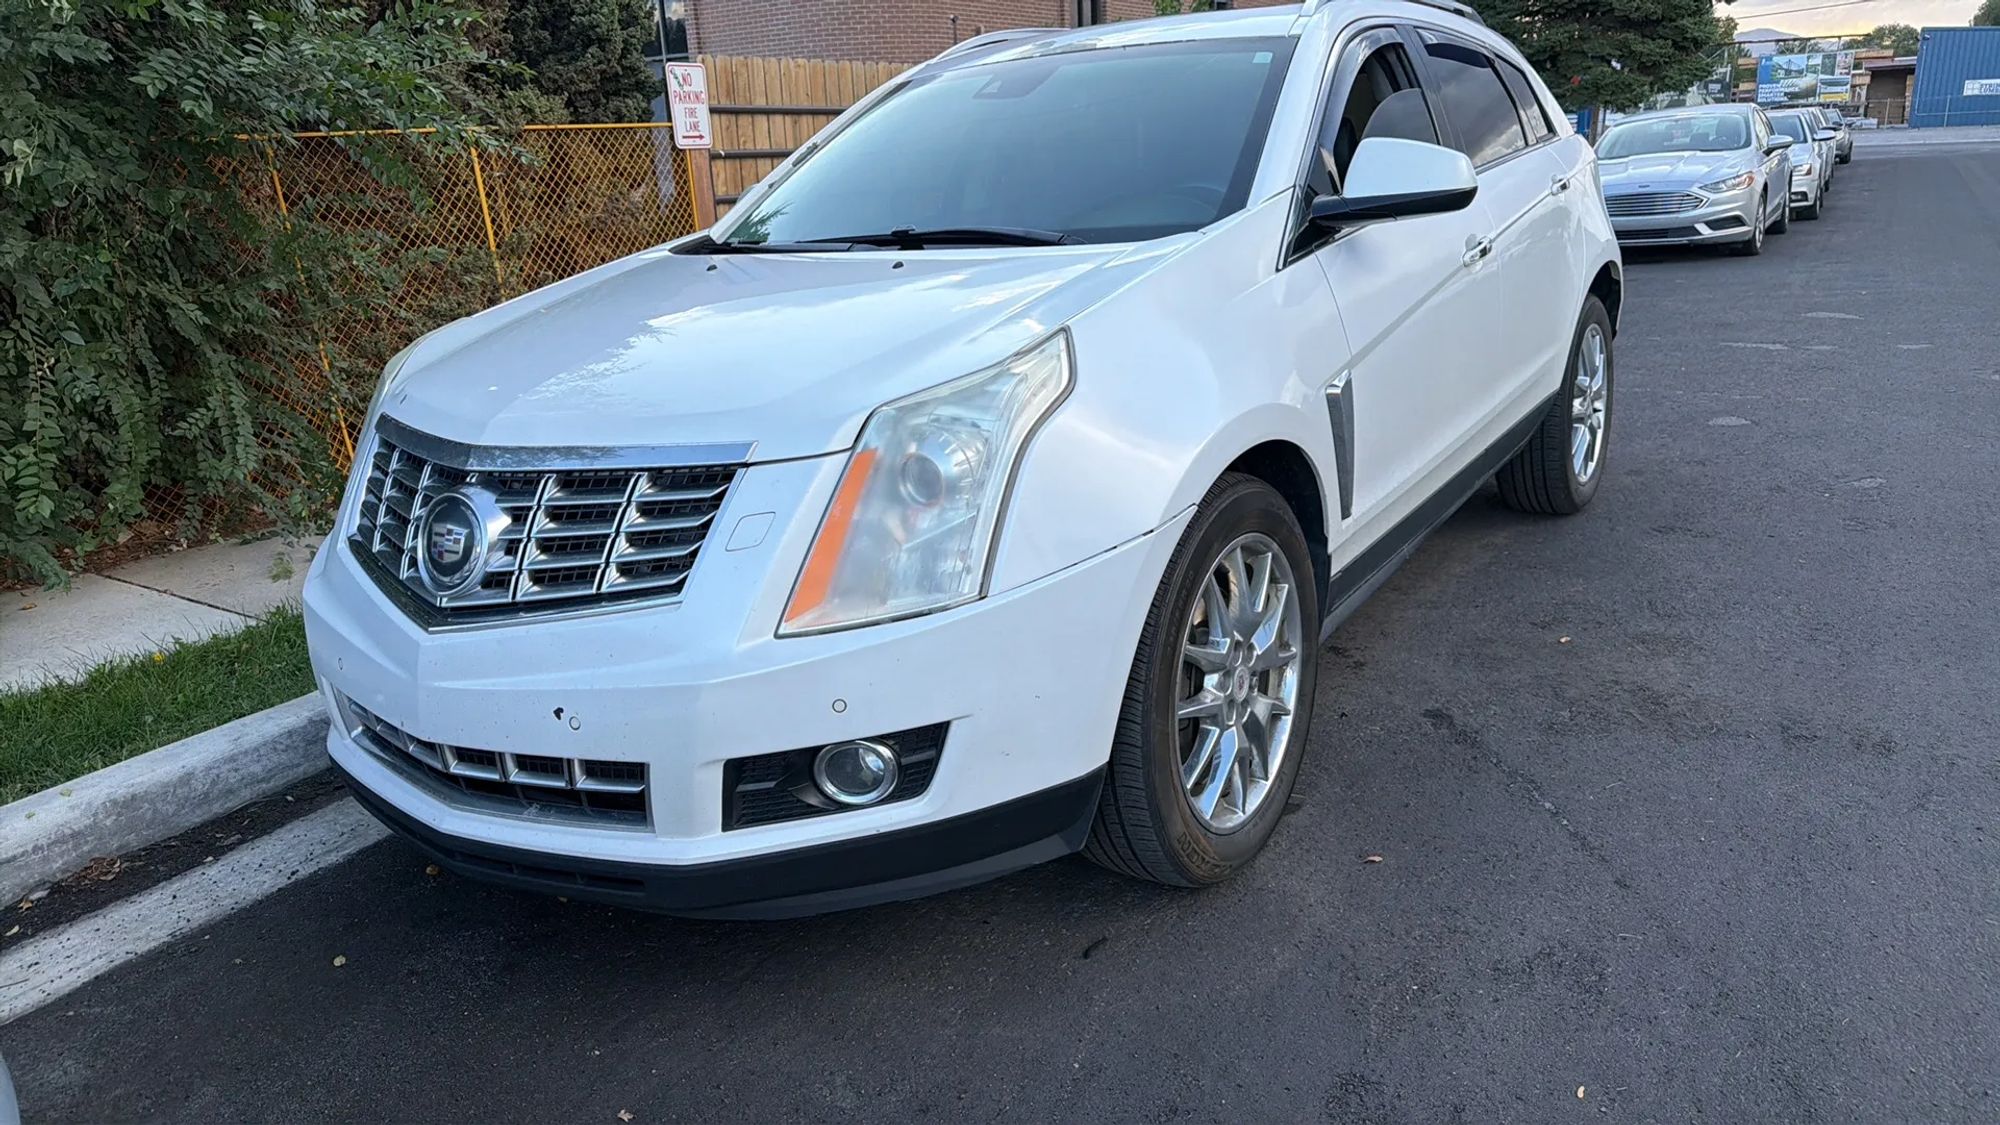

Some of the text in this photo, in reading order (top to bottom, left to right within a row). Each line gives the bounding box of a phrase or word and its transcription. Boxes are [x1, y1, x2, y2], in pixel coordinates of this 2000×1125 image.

[681, 72, 692, 87] NO
[673, 90, 705, 105] PARKING
[684, 107, 698, 119] FIRE
[684, 120, 701, 132] LANE
